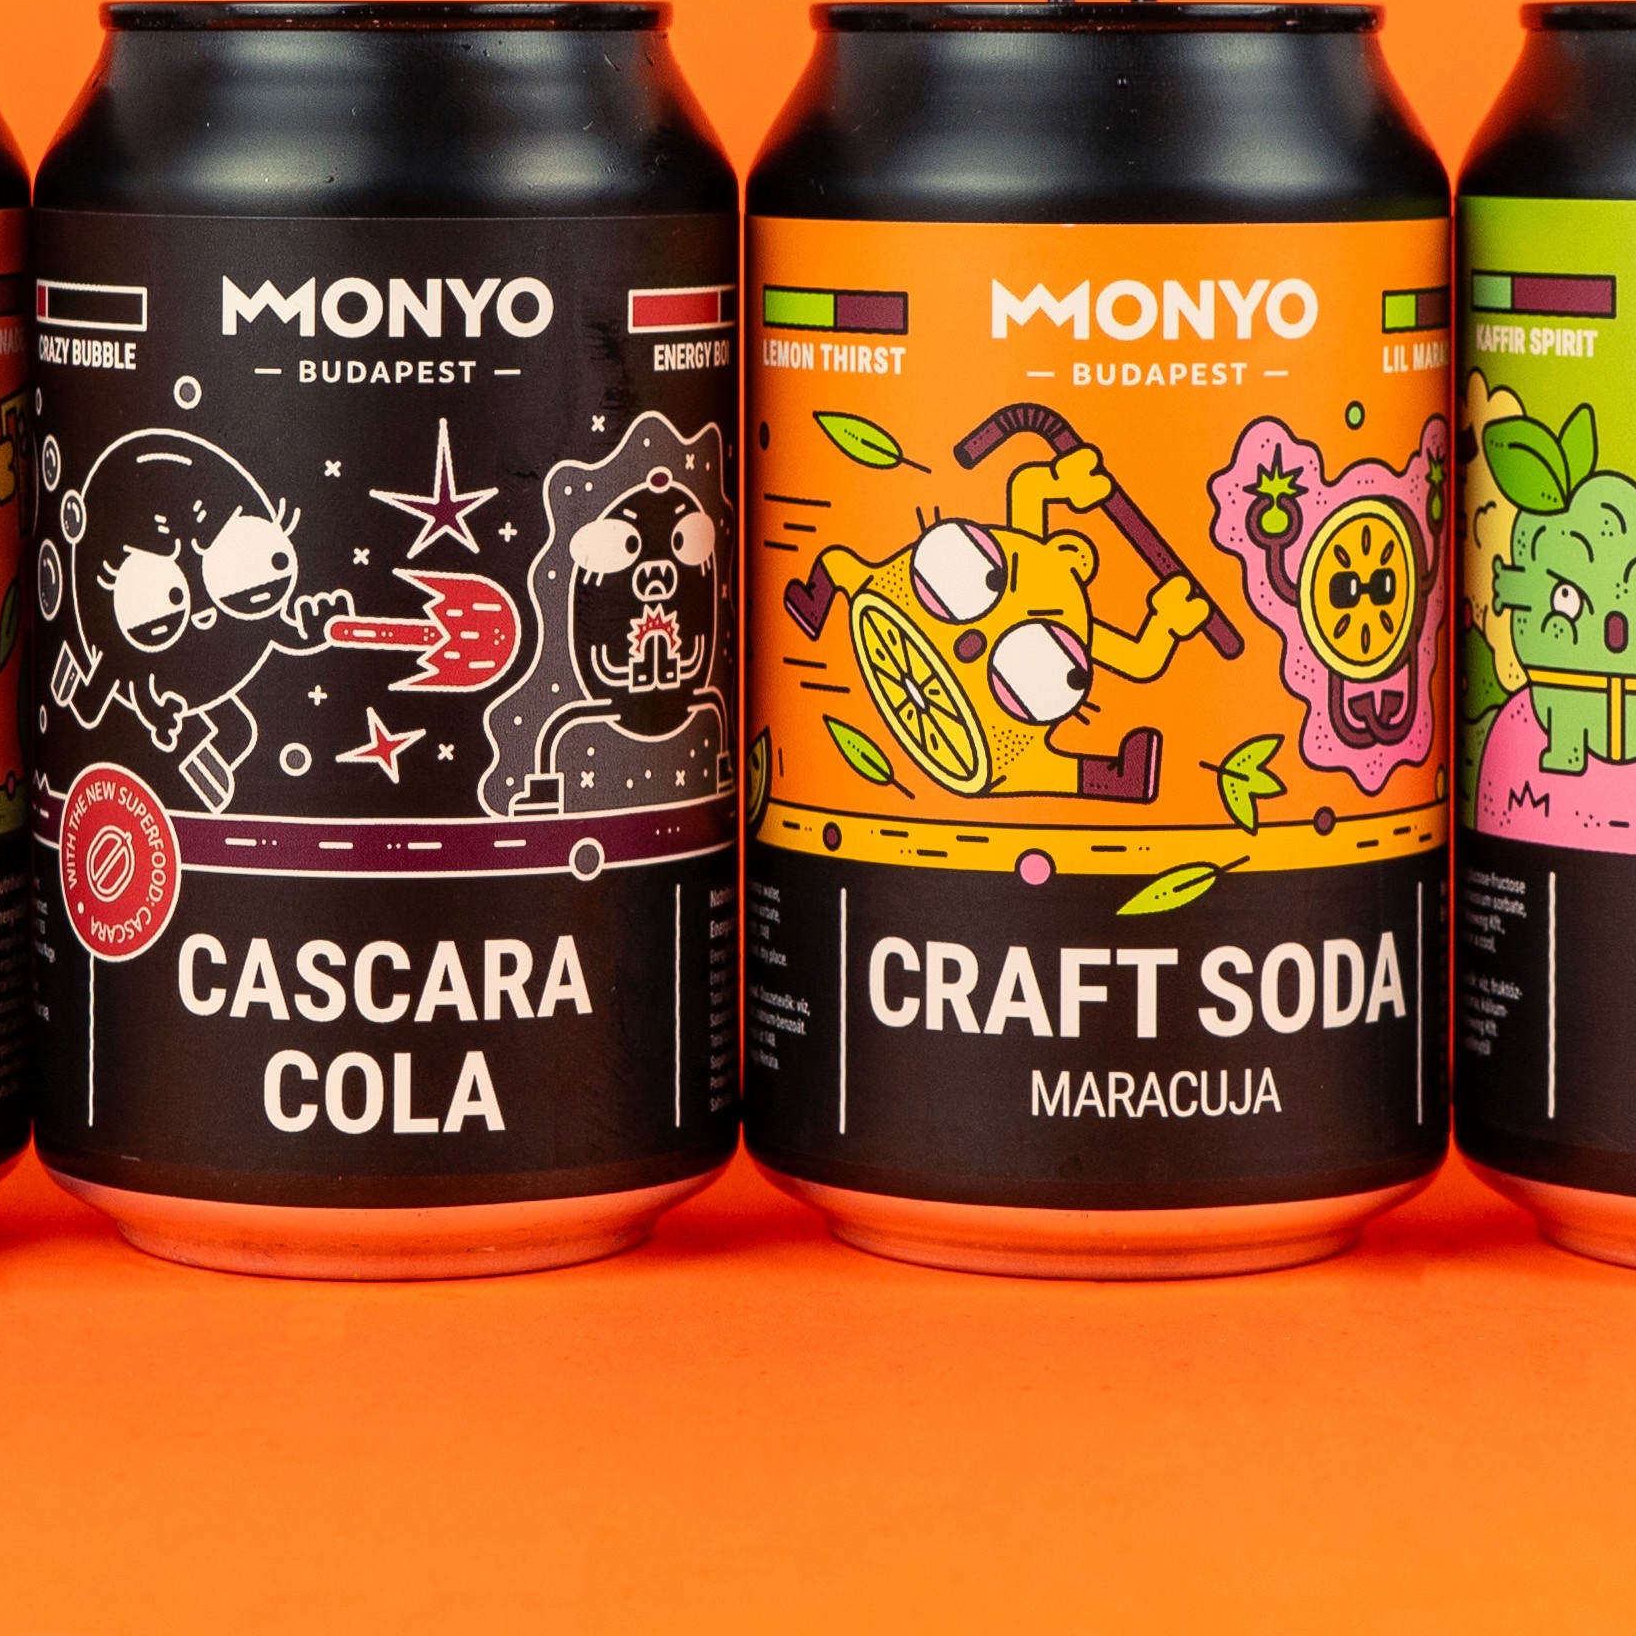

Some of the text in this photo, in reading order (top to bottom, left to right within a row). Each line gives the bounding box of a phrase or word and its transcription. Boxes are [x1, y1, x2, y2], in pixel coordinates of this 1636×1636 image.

[222, 275, 554, 339] MONYO
[991, 278, 1318, 341] MONYO
[39, 333, 137, 370] CRAZY BUBBLE
[654, 341, 712, 372] ENERGY
[763, 339, 907, 375] LEMON THIRST
[1383, 343, 1409, 374] LIL
[1475, 323, 1599, 358] KAFFIR SPIRIT
[299, 359, 477, 384] BUDAPEST
[1073, 363, 1247, 386] BUDAPEST
[85, 780, 117, 804] NEW
[68, 794, 89, 831] THE
[66, 833, 78, 890] WITH
[90, 905, 153, 944] CASCARA
[178, 933, 593, 1023] CASCARA
[869, 936, 1178, 1038] CRAFT
[1198, 932, 1406, 1037] SODA
[263, 1049, 506, 1135] COLA
[1031, 1067, 1282, 1118] MARACUJA
